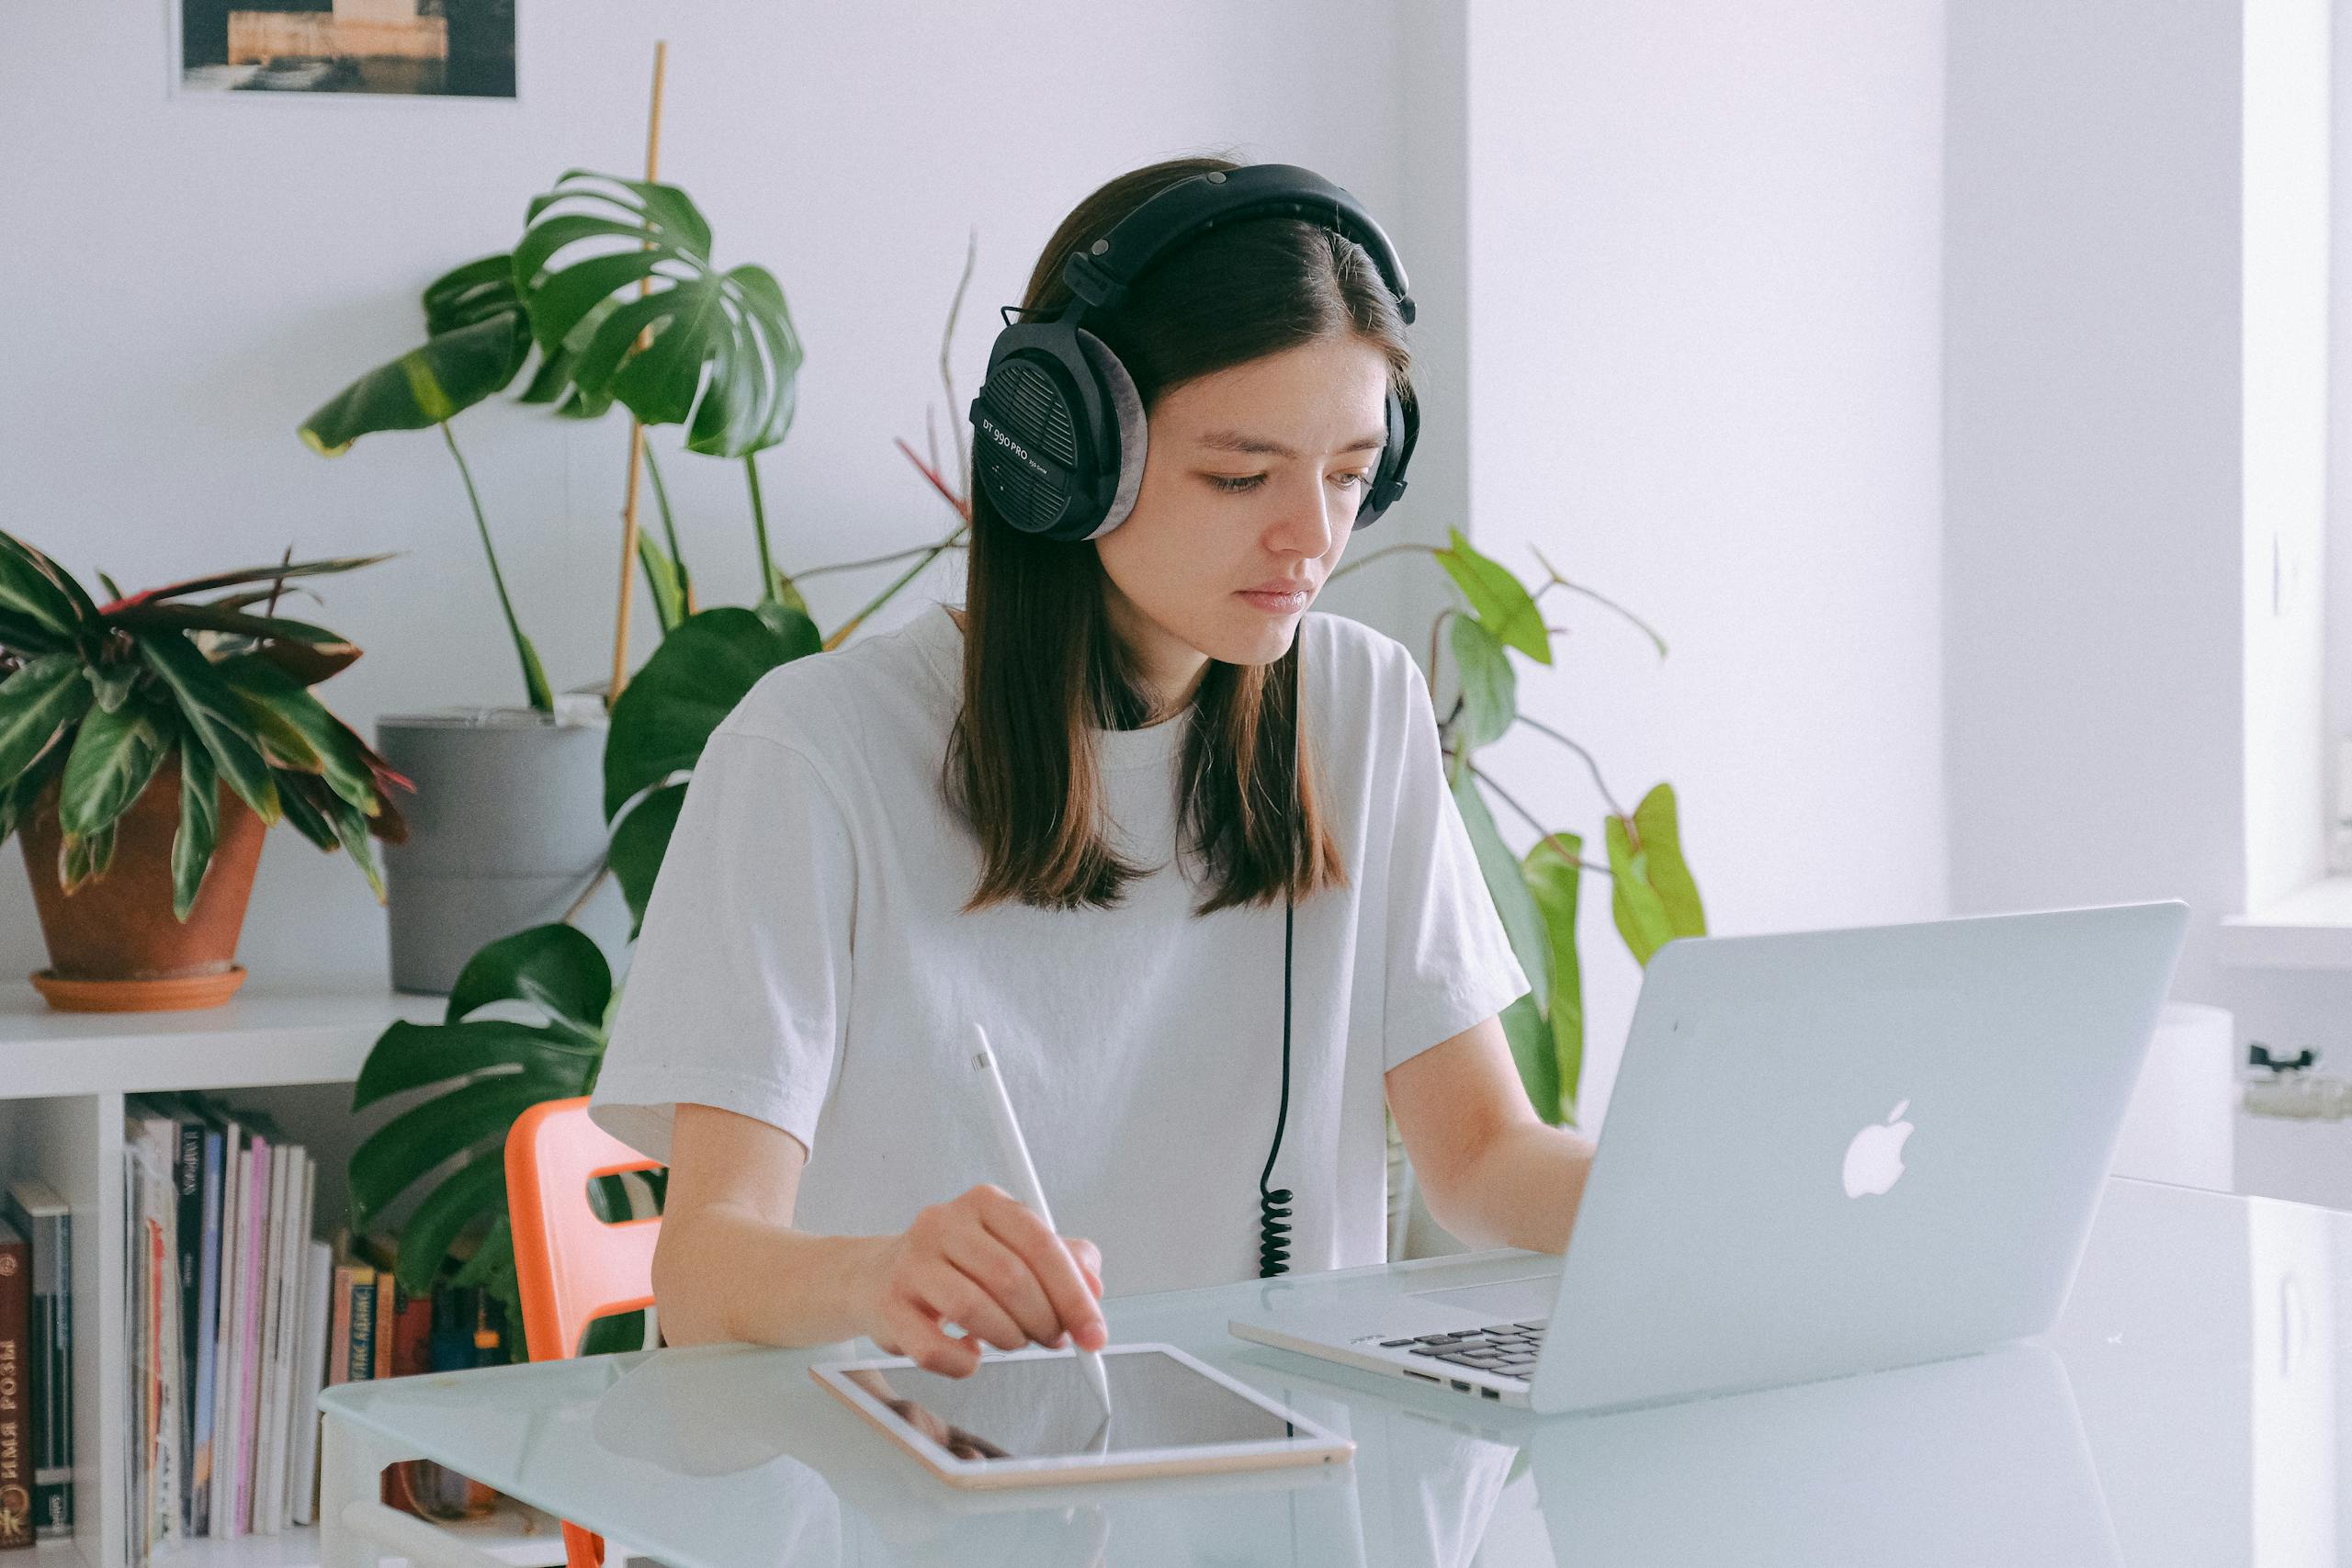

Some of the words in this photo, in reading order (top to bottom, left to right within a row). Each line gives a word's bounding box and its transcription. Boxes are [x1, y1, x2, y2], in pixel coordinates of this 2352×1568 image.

[983, 419, 993, 432] DT
[993, 429, 1010, 446] 990
[1011, 442, 1027, 459] PRO
[0, 1339, 17, 1410] РОЗЫ
[0, 1422, 17, 1479] ИМЯ
